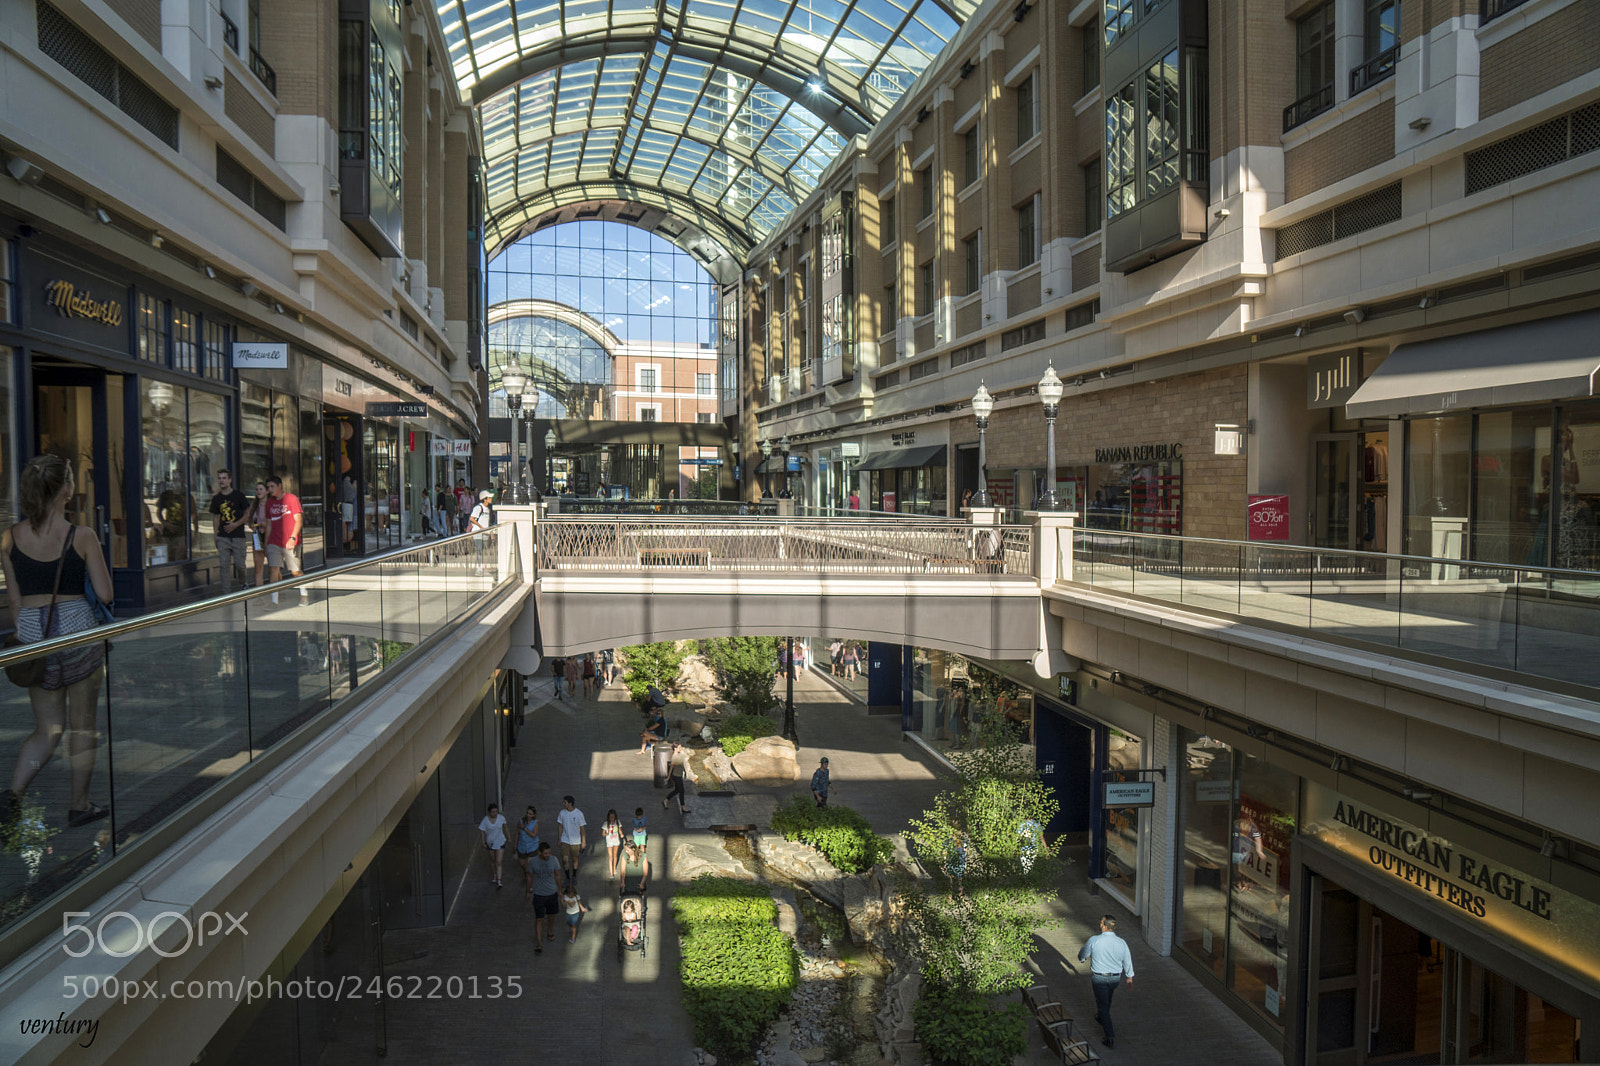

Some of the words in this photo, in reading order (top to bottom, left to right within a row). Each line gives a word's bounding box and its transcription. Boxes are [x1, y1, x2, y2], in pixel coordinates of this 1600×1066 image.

[52, 279, 123, 327] Madewell
[237, 349, 281, 360] Madewell
[397, 405, 425, 413] J.CREW
[1095, 446, 1132, 462] BANANA
[1133, 442, 1183, 461] REPUBLIC
[1241, 846, 1272, 878] SALE
[1333, 800, 1452, 873] AMERICAN
[1458, 854, 1551, 921] EAGLE
[1368, 845, 1487, 918] OUTFITTERS
